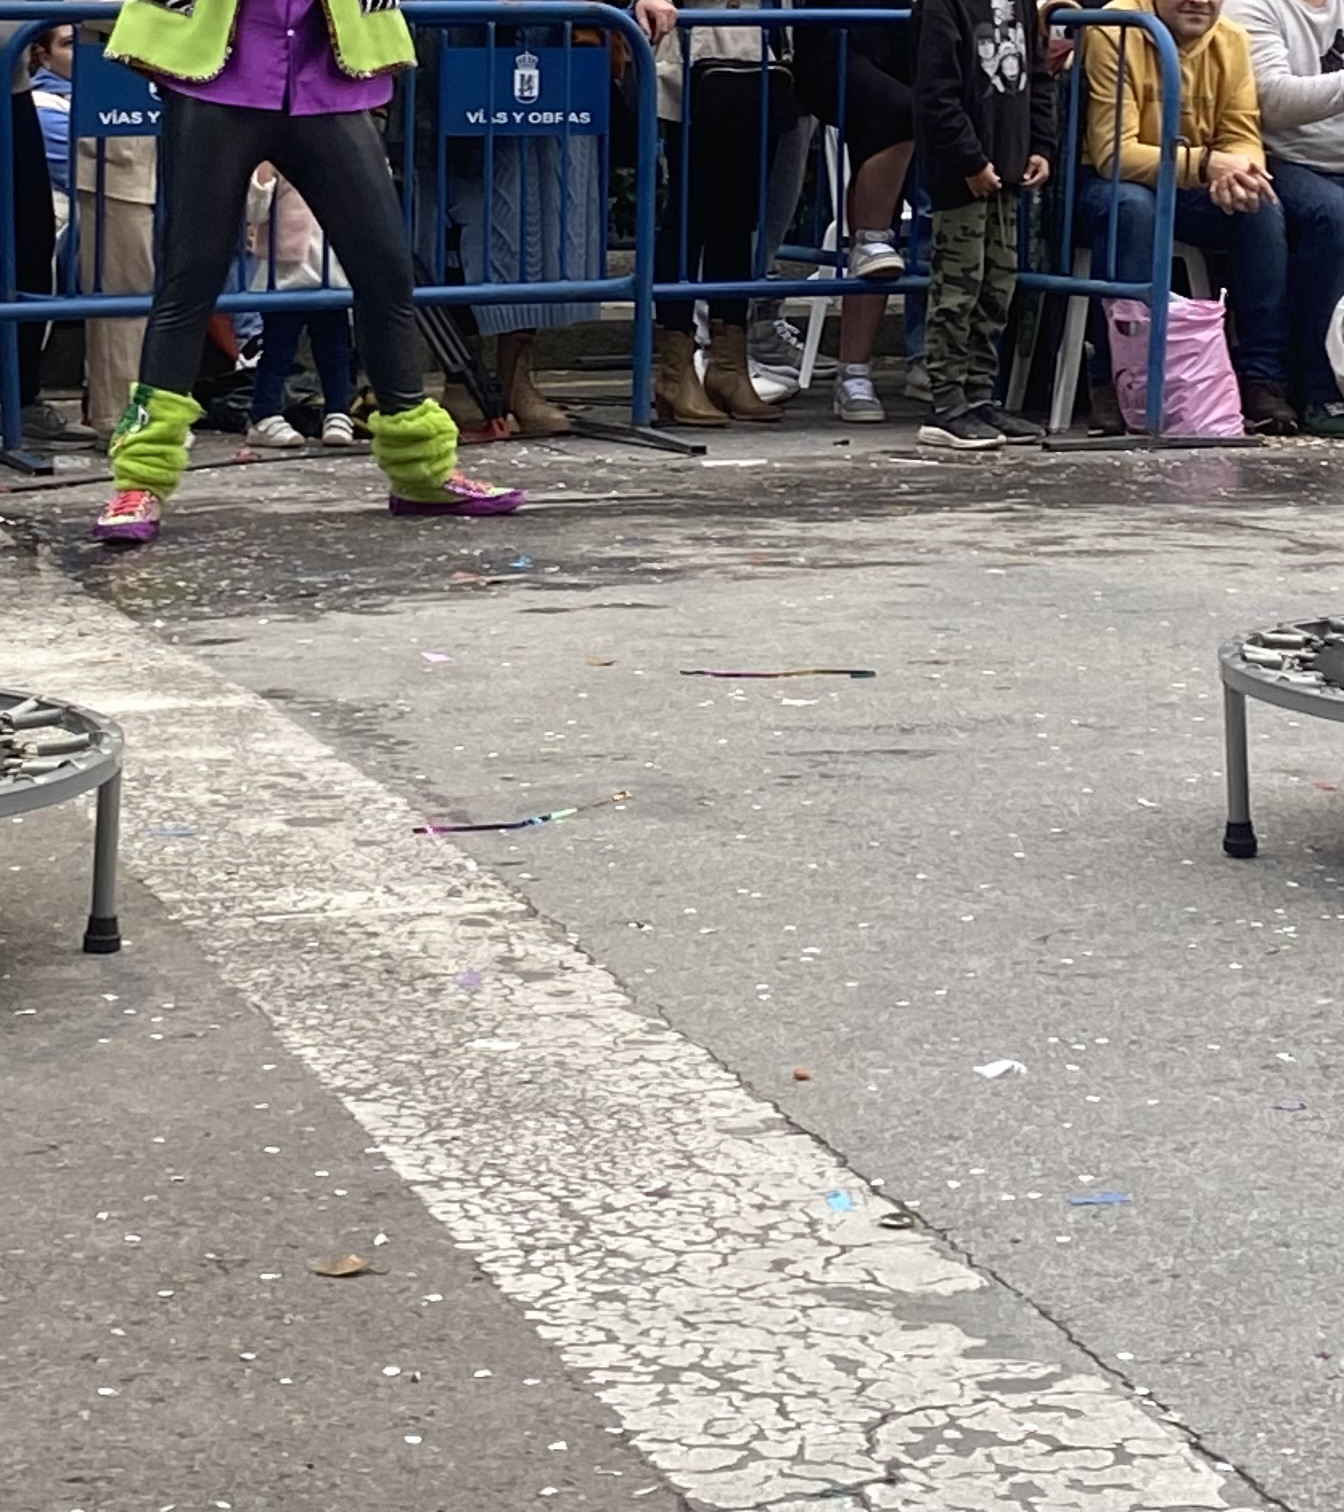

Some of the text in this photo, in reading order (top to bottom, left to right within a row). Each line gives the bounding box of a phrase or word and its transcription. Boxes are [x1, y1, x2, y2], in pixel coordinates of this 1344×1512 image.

[98, 108, 161, 125] VÍAS Y
[512, 111, 525, 124] Y
